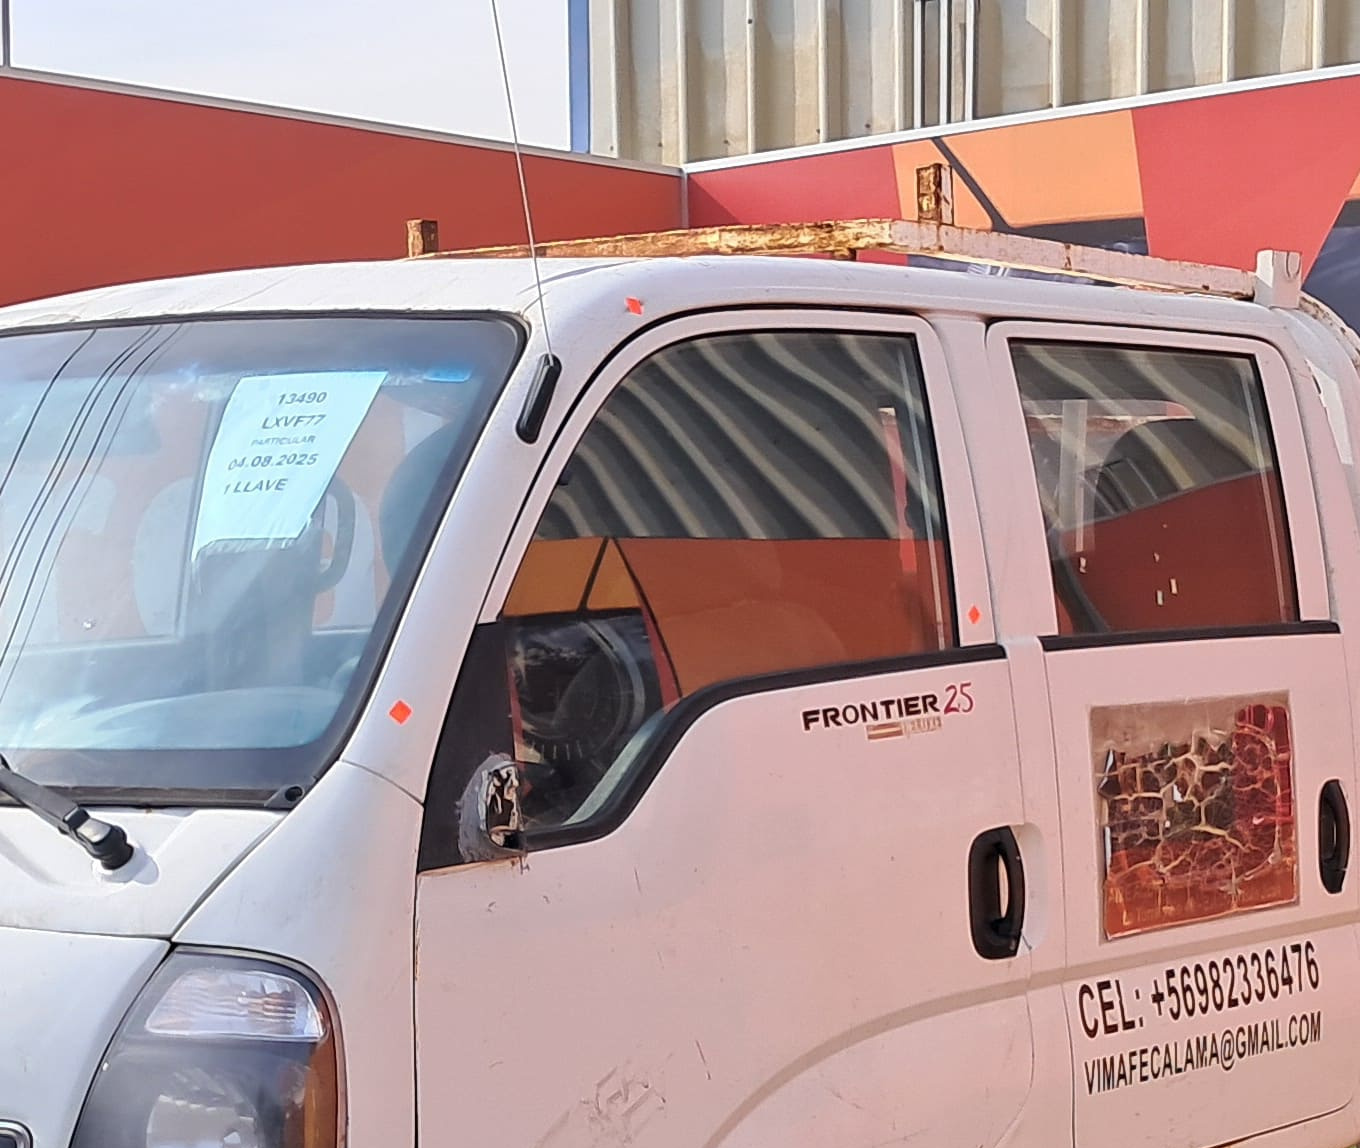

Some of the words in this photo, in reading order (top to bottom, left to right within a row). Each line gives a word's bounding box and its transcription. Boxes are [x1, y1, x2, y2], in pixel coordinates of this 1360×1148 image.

[278, 391, 328, 406] 13490
[261, 414, 327, 430] LXVF77
[227, 452, 319, 471] 04.08.2025
[232, 478, 289, 494] LLAVE
[802, 693, 941, 732] FRONTIER
[1078, 979, 1144, 1039] CEL:
[1150, 940, 1320, 1021] +56982336476
[1084, 1010, 1322, 1095] VIMAFECALAMA@GMAIL.COM
